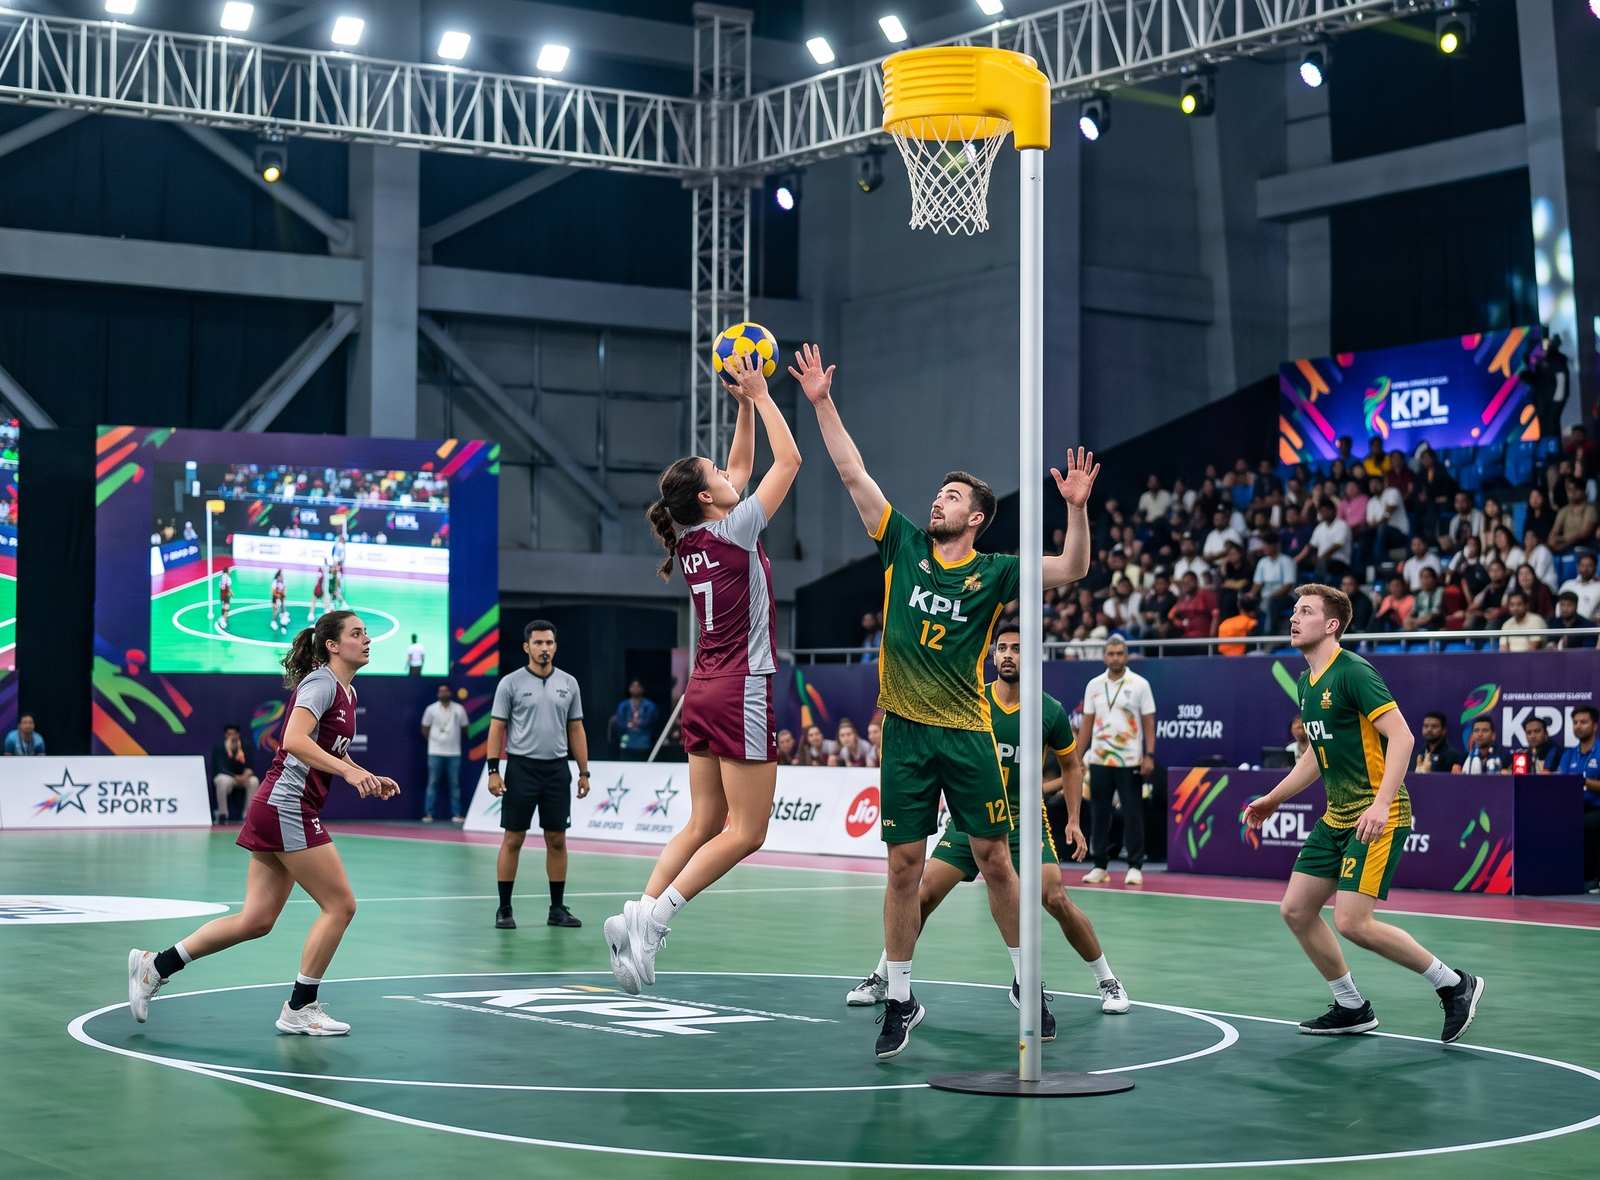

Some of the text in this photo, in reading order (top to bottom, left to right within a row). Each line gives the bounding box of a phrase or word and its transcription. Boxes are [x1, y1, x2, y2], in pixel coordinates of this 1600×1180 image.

[1391, 387, 1449, 421] KPL
[681, 550, 720, 574] KPL
[691, 581, 714, 631] 7
[908, 585, 968, 622] KPL
[920, 620, 946, 650] 12
[1156, 720, 1223, 739] HOTSTAR
[1303, 720, 1333, 740] KPL
[1502, 706, 1580, 748] KPL
[97, 781, 149, 797] STAR
[97, 798, 178, 814] SPORTS
[848, 797, 878, 825] Jio
[985, 799, 1007, 824] 12
[1262, 811, 1311, 840] KPL
[1341, 857, 1357, 878] 12
[423, 987, 776, 1035] KPL
